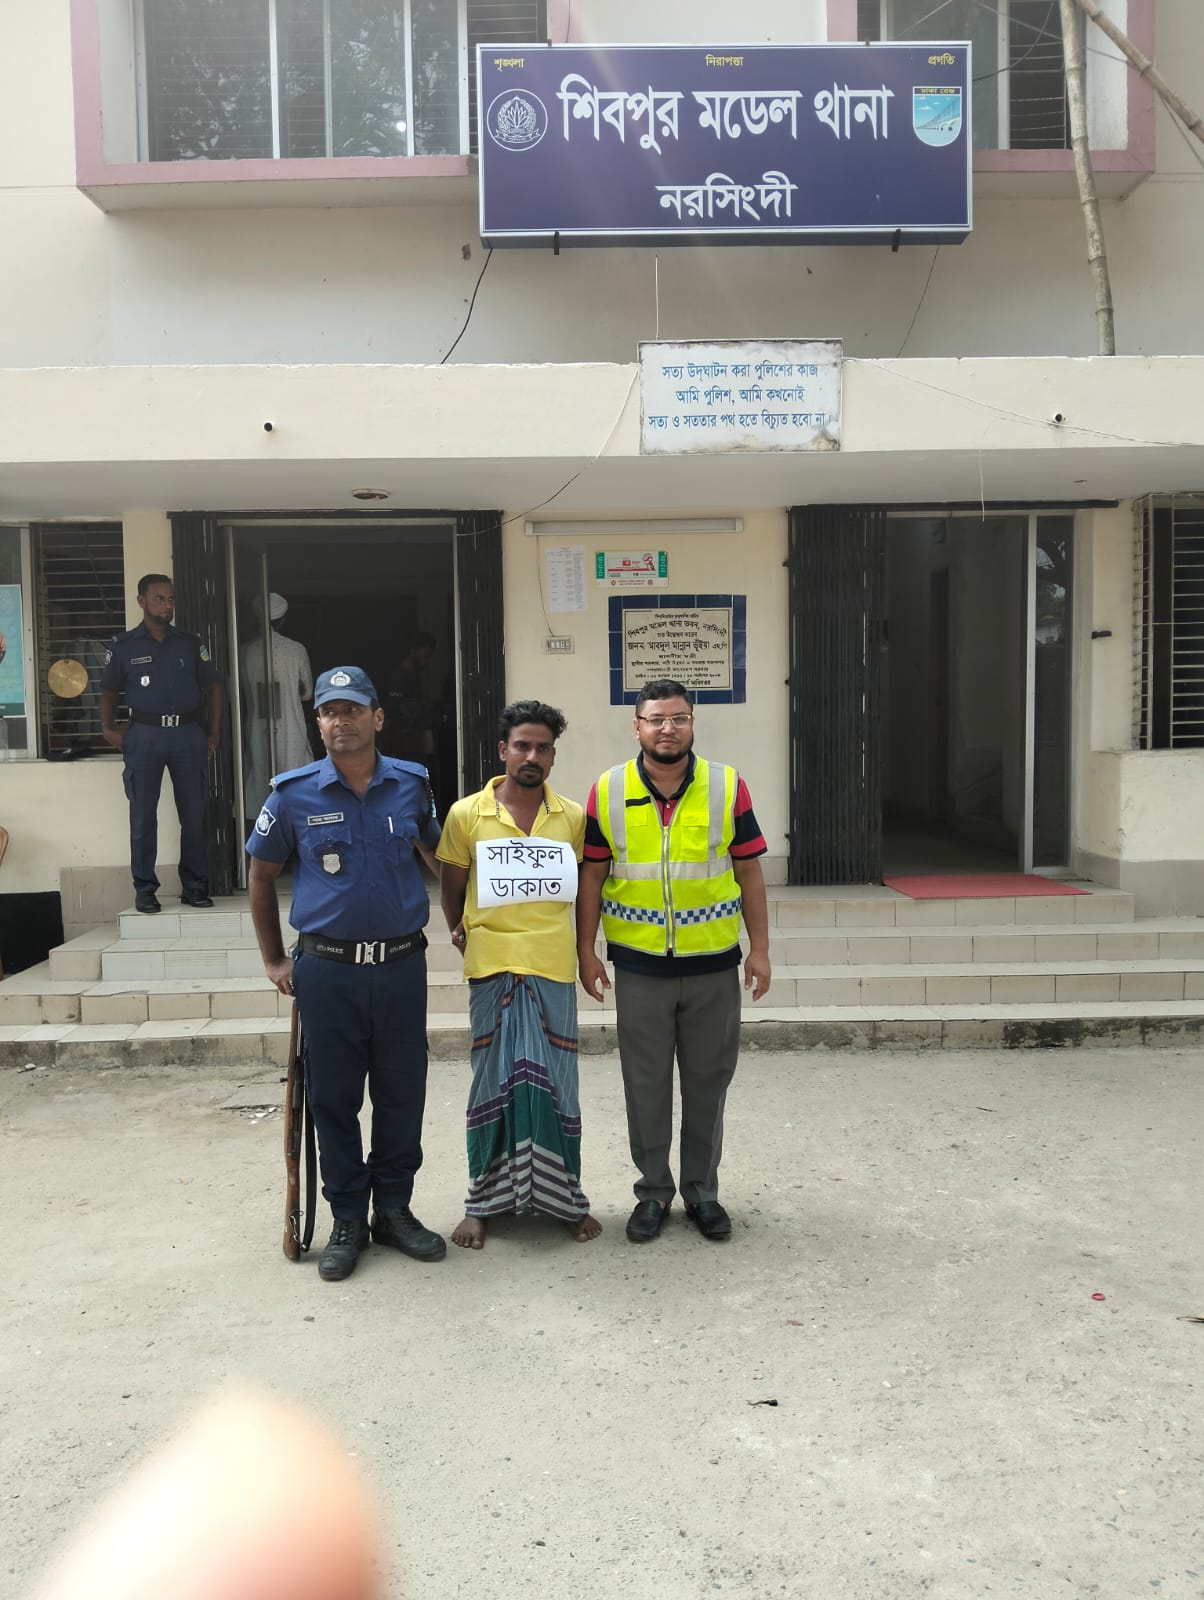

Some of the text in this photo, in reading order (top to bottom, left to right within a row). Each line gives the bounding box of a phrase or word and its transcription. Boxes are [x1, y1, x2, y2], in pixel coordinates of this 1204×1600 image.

[705, 53, 744, 67] নিরাপত্তা
[928, 53, 956, 65] প্রগতি
[556, 73, 895, 155] শিবপুর মডেল থানা
[654, 169, 799, 221] নরসিংদী
[661, 365, 683, 380] সত্য
[730, 363, 750, 379] করা
[754, 359, 793, 382] পুলিশের
[797, 362, 819, 378] কাজ
[676, 383, 806, 406] আমি পুলিশ, আমি কখনোই
[648, 415, 668, 430] সত্য
[672, 415, 680, 428] ও
[683, 413, 717, 429] সততার
[720, 413, 735, 429] পথ
[738, 413, 758, 428] হতে
[761, 409, 789, 431] বিচ্যুত
[791, 413, 812, 428] হবো
[486, 840, 564, 868] সাইফুল
[489, 878, 562, 897] ডাকাত
